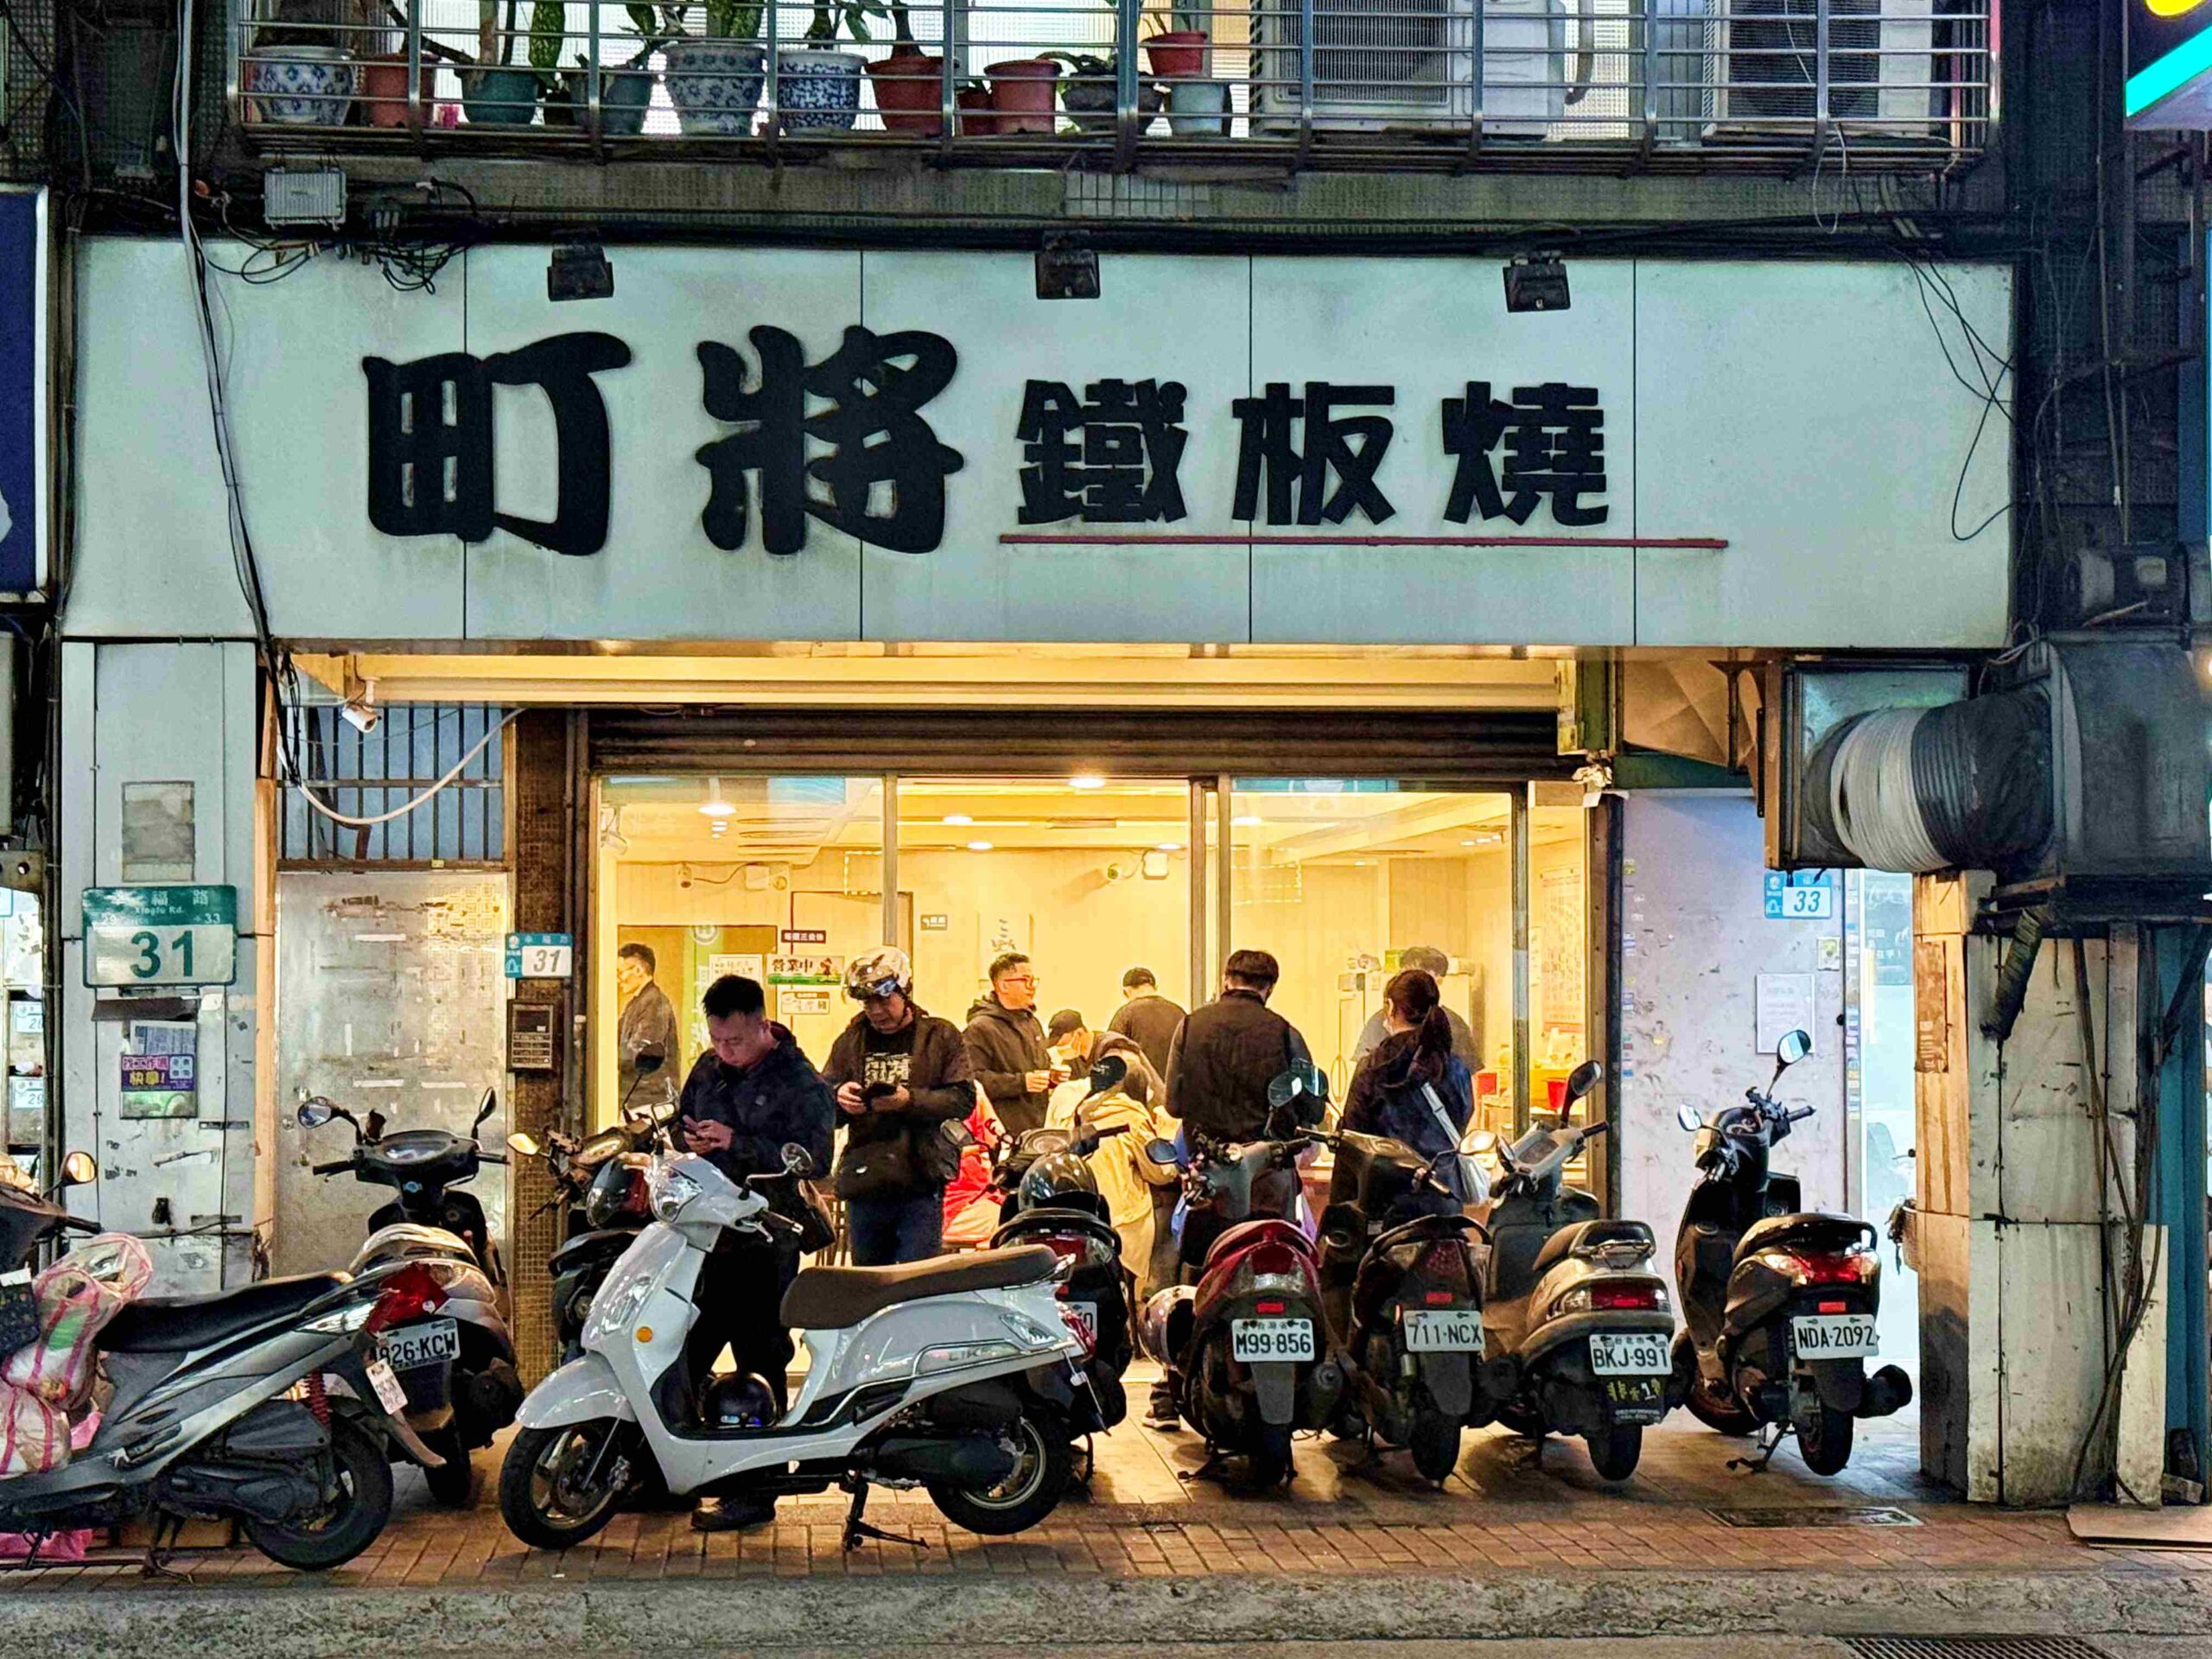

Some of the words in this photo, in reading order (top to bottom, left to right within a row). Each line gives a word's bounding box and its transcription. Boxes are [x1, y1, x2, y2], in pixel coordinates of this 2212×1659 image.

[1016, 378, 1609, 526] 鐵板燒
[1793, 890, 1821, 913] 33
[204, 912, 221, 925] 33
[130, 931, 194, 979] 31
[533, 948, 562, 974] 31
[1236, 1333, 1312, 1354] M99-856
[1408, 1324, 1483, 1344] 711-NCX
[1798, 1325, 1876, 1349] NDA-2092
[1592, 1348, 1668, 1368] BKJ-991
